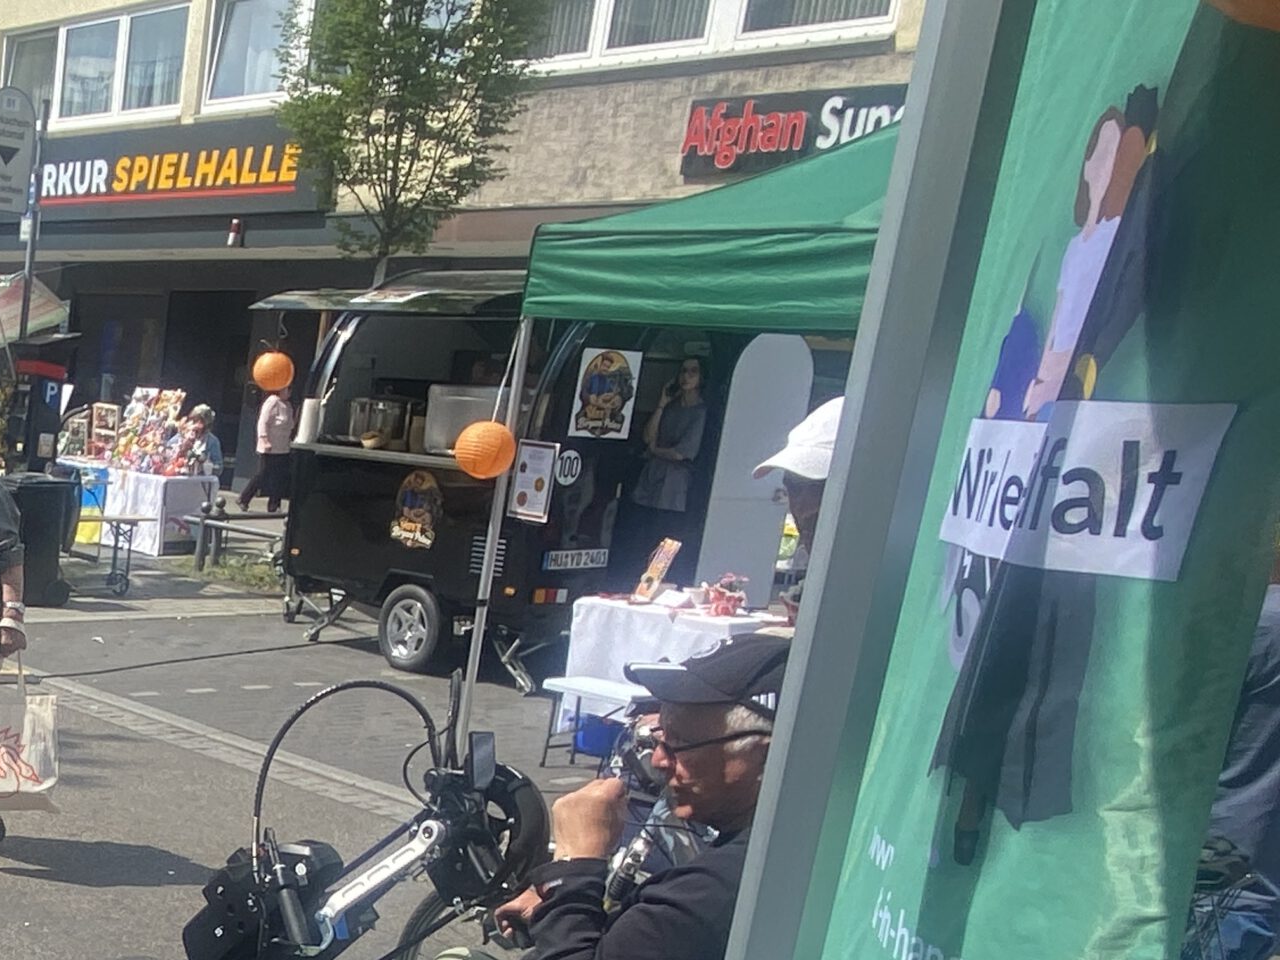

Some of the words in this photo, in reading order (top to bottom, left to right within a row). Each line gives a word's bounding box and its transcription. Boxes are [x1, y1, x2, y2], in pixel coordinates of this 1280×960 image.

[681, 98, 807, 168] Afghan
[41, 159, 109, 197] RKUR
[111, 143, 303, 193] SPIELHALLE
[558, 455, 580, 474] 100
